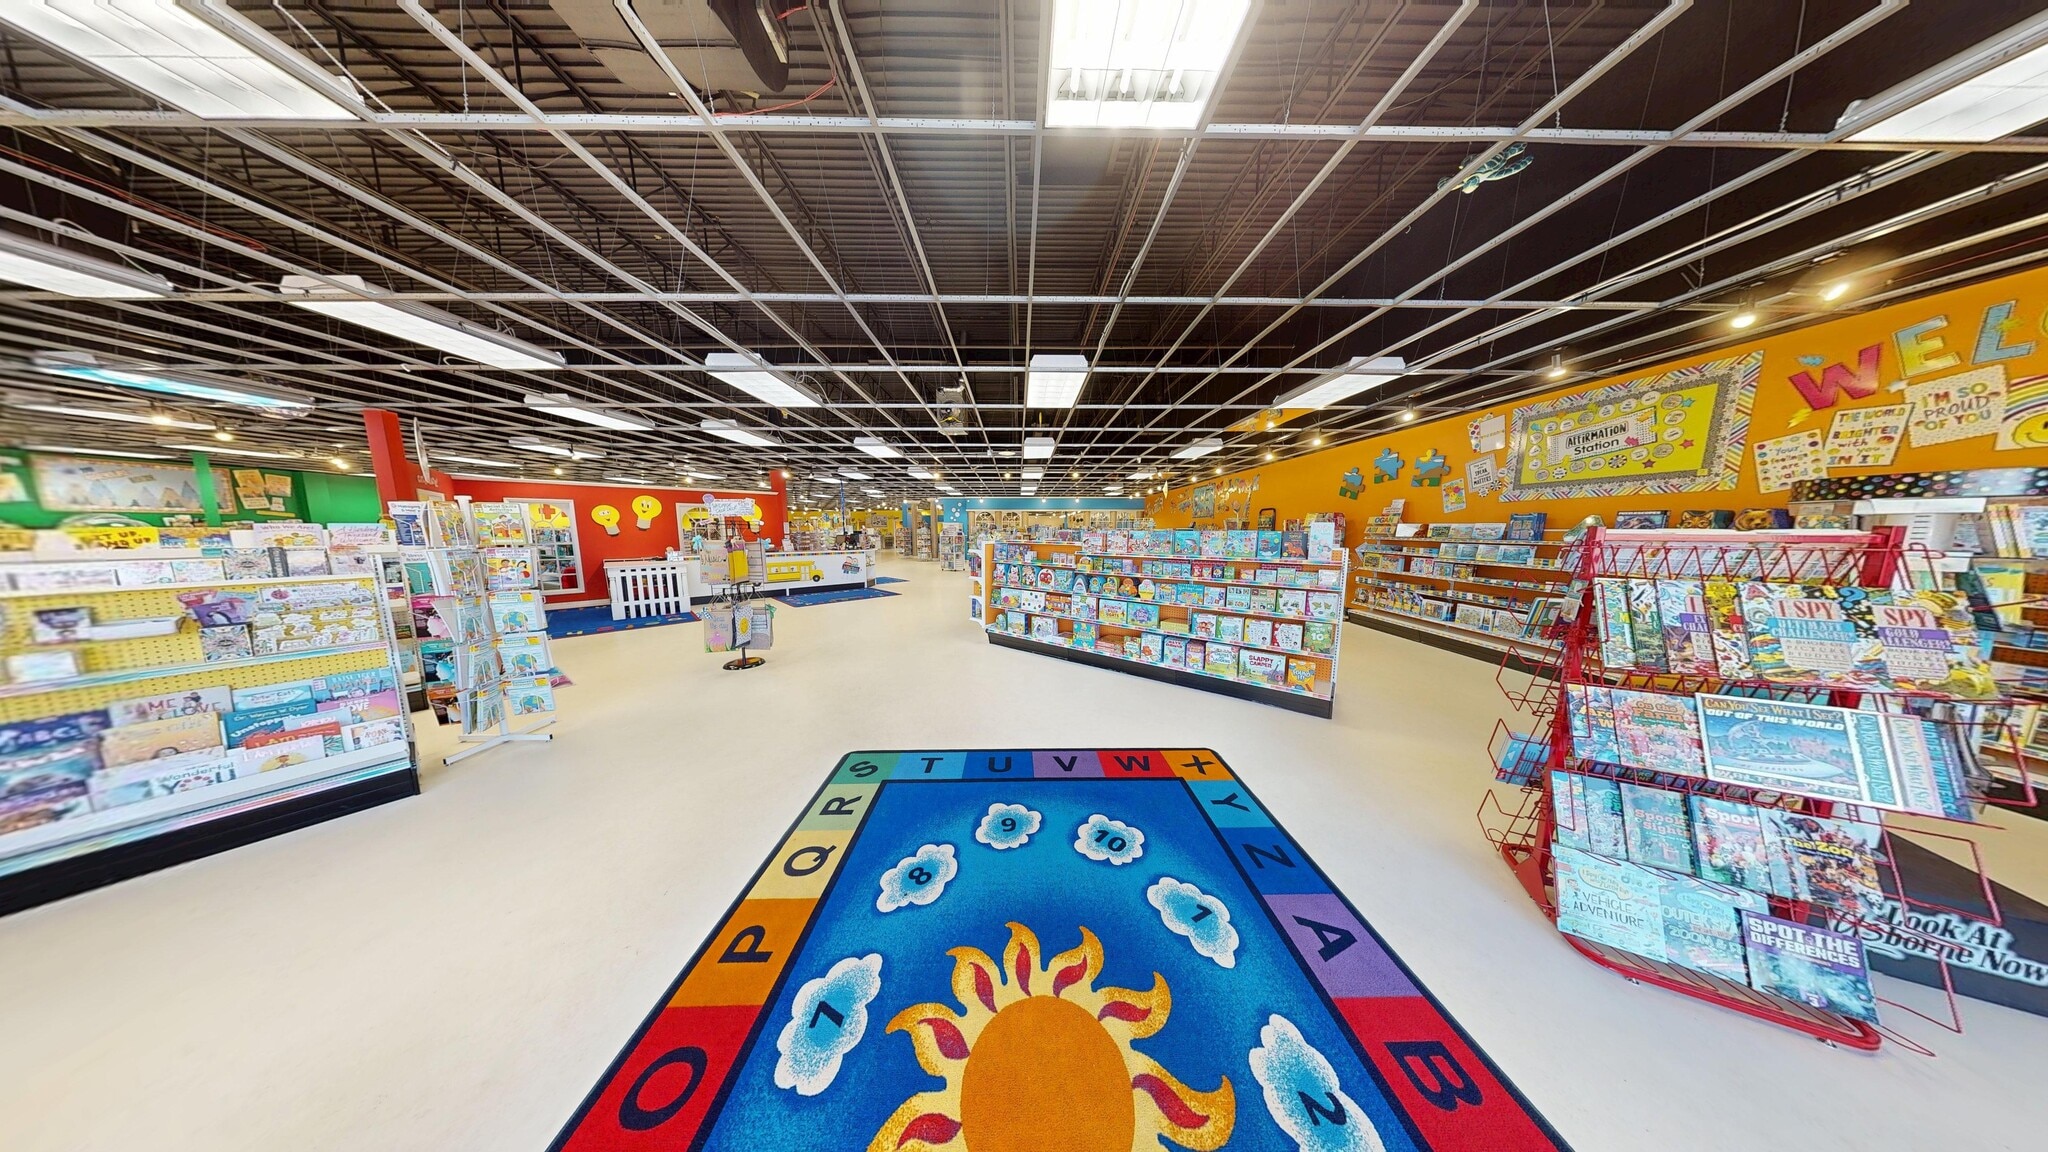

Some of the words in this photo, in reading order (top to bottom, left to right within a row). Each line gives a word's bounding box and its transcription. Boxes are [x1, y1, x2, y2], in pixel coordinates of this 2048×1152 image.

[1788, 299, 2048, 411] WEL
[1921, 390, 1950, 406] I'M
[1957, 383, 1987, 398] SO
[1838, 411, 1859, 423] THE
[1865, 406, 1904, 419] WORLD
[1923, 397, 1990, 419] PROUD
[1924, 418, 1947, 431] OF
[1956, 410, 1991, 425] YOU
[1832, 425, 1899, 440] BRIGHTER
[1837, 438, 1868, 449] with
[1573, 437, 1620, 456] Station
[1827, 455, 1852, 465] IN
[1858, 453, 1885, 465] IT
[1779, 600, 1788, 617] I
[1793, 601, 1836, 620] SPY
[1883, 608, 1928, 627] SPY
[1632, 707, 1685, 723] Farm
[1705, 708, 1734, 717] OUT
[1734, 712, 1754, 720] OF
[1756, 714, 1788, 724] THIS
[1791, 719, 1845, 731] WORLD
[852, 759, 879, 779] S
[920, 757, 944, 774] T
[988, 756, 1013, 774] U
[1052, 755, 1079, 773] V
[1112, 754, 1154, 772] W
[1181, 754, 1215, 775] X
[818, 793, 864, 817] R
[1209, 792, 1251, 814] Y
[1000, 817, 1018, 834] 9
[1095, 828, 1129, 855] 10
[1813, 841, 1854, 857] Zoo
[783, 844, 837, 877] Q
[1241, 843, 1297, 870] Z
[907, 866, 934, 886] 8
[1190, 904, 1214, 924] 1
[1582, 891, 1633, 914] VEHICLE
[1573, 900, 1645, 929] ADVENTURE
[1291, 913, 1359, 962] A
[1748, 917, 1809, 940] SPOT
[1812, 932, 1859, 957] THE
[1886, 906, 1963, 940] Look
[1966, 925, 2007, 949] At
[716, 924, 774, 964] P
[1751, 931, 1862, 969] DIFFERENCES
[1808, 995, 1820, 1007] 3
[808, 1000, 846, 1029] 7
[1383, 1040, 1484, 1112] B
[618, 1045, 708, 1132] O
[1297, 1089, 1348, 1127] 2
